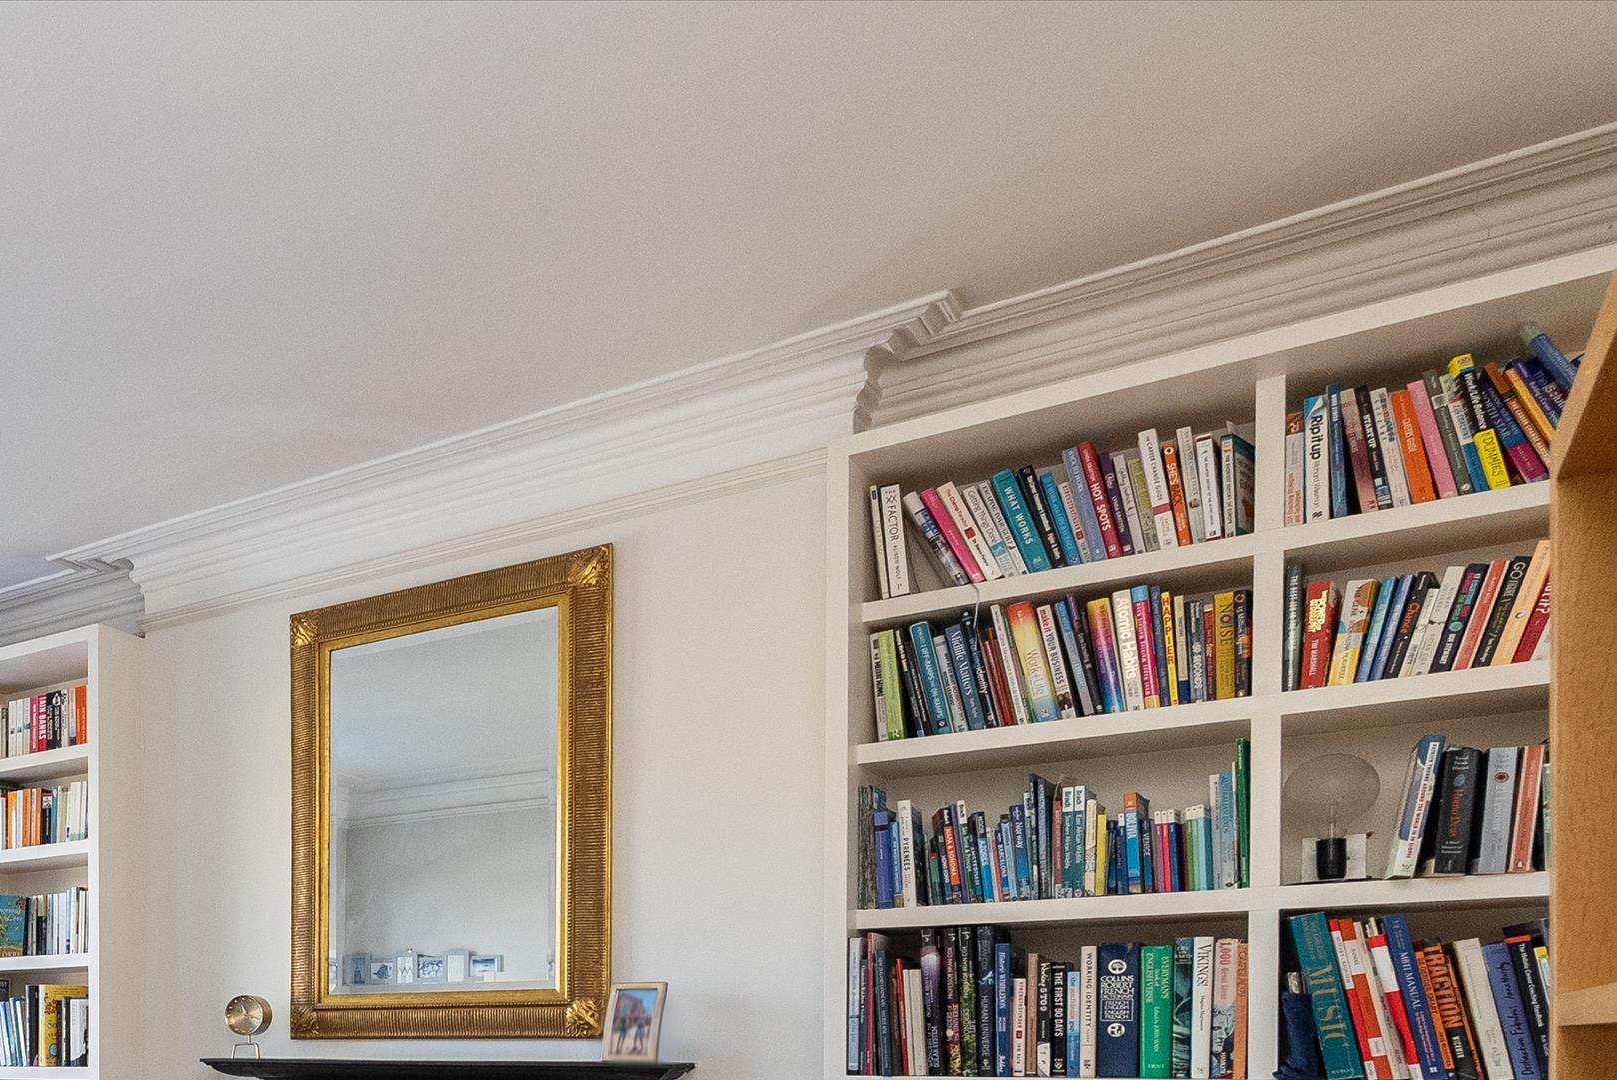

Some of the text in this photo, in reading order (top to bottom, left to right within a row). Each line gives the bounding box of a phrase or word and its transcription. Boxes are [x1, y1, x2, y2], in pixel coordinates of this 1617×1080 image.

[1465, 373, 1486, 429] Work/Life Balance
[1310, 415, 1323, 434] Rip
[1363, 414, 1376, 448] START UP
[1310, 444, 1321, 460] up
[1484, 437, 1503, 476] DUMMIES
[1168, 463, 1178, 485] SHE'S
[888, 505, 898, 541] FACTOR
[949, 496, 960, 511] Chimp
[968, 490, 981, 513] Getting
[978, 511, 990, 529] Things
[1004, 486, 1033, 544] WHAT WORKS
[1090, 482, 1111, 531] HOT SPOTS
[1046, 633, 1057, 651] YOUR
[1117, 598, 1138, 679] Atomic Habits
[1162, 598, 1175, 664] HAPPIER
[1219, 604, 1233, 646] NOISE
[949, 631, 973, 696] Midlife Matters
[1050, 653, 1063, 684] BUSINESS
[1127, 813, 1136, 839] BOLIVIA
[1449, 789, 1464, 837] Homo Deus
[1197, 944, 1211, 986] VIKINGS!
[1405, 972, 1421, 1009] MANUAL
[1423, 945, 1464, 1028] TRACTION
